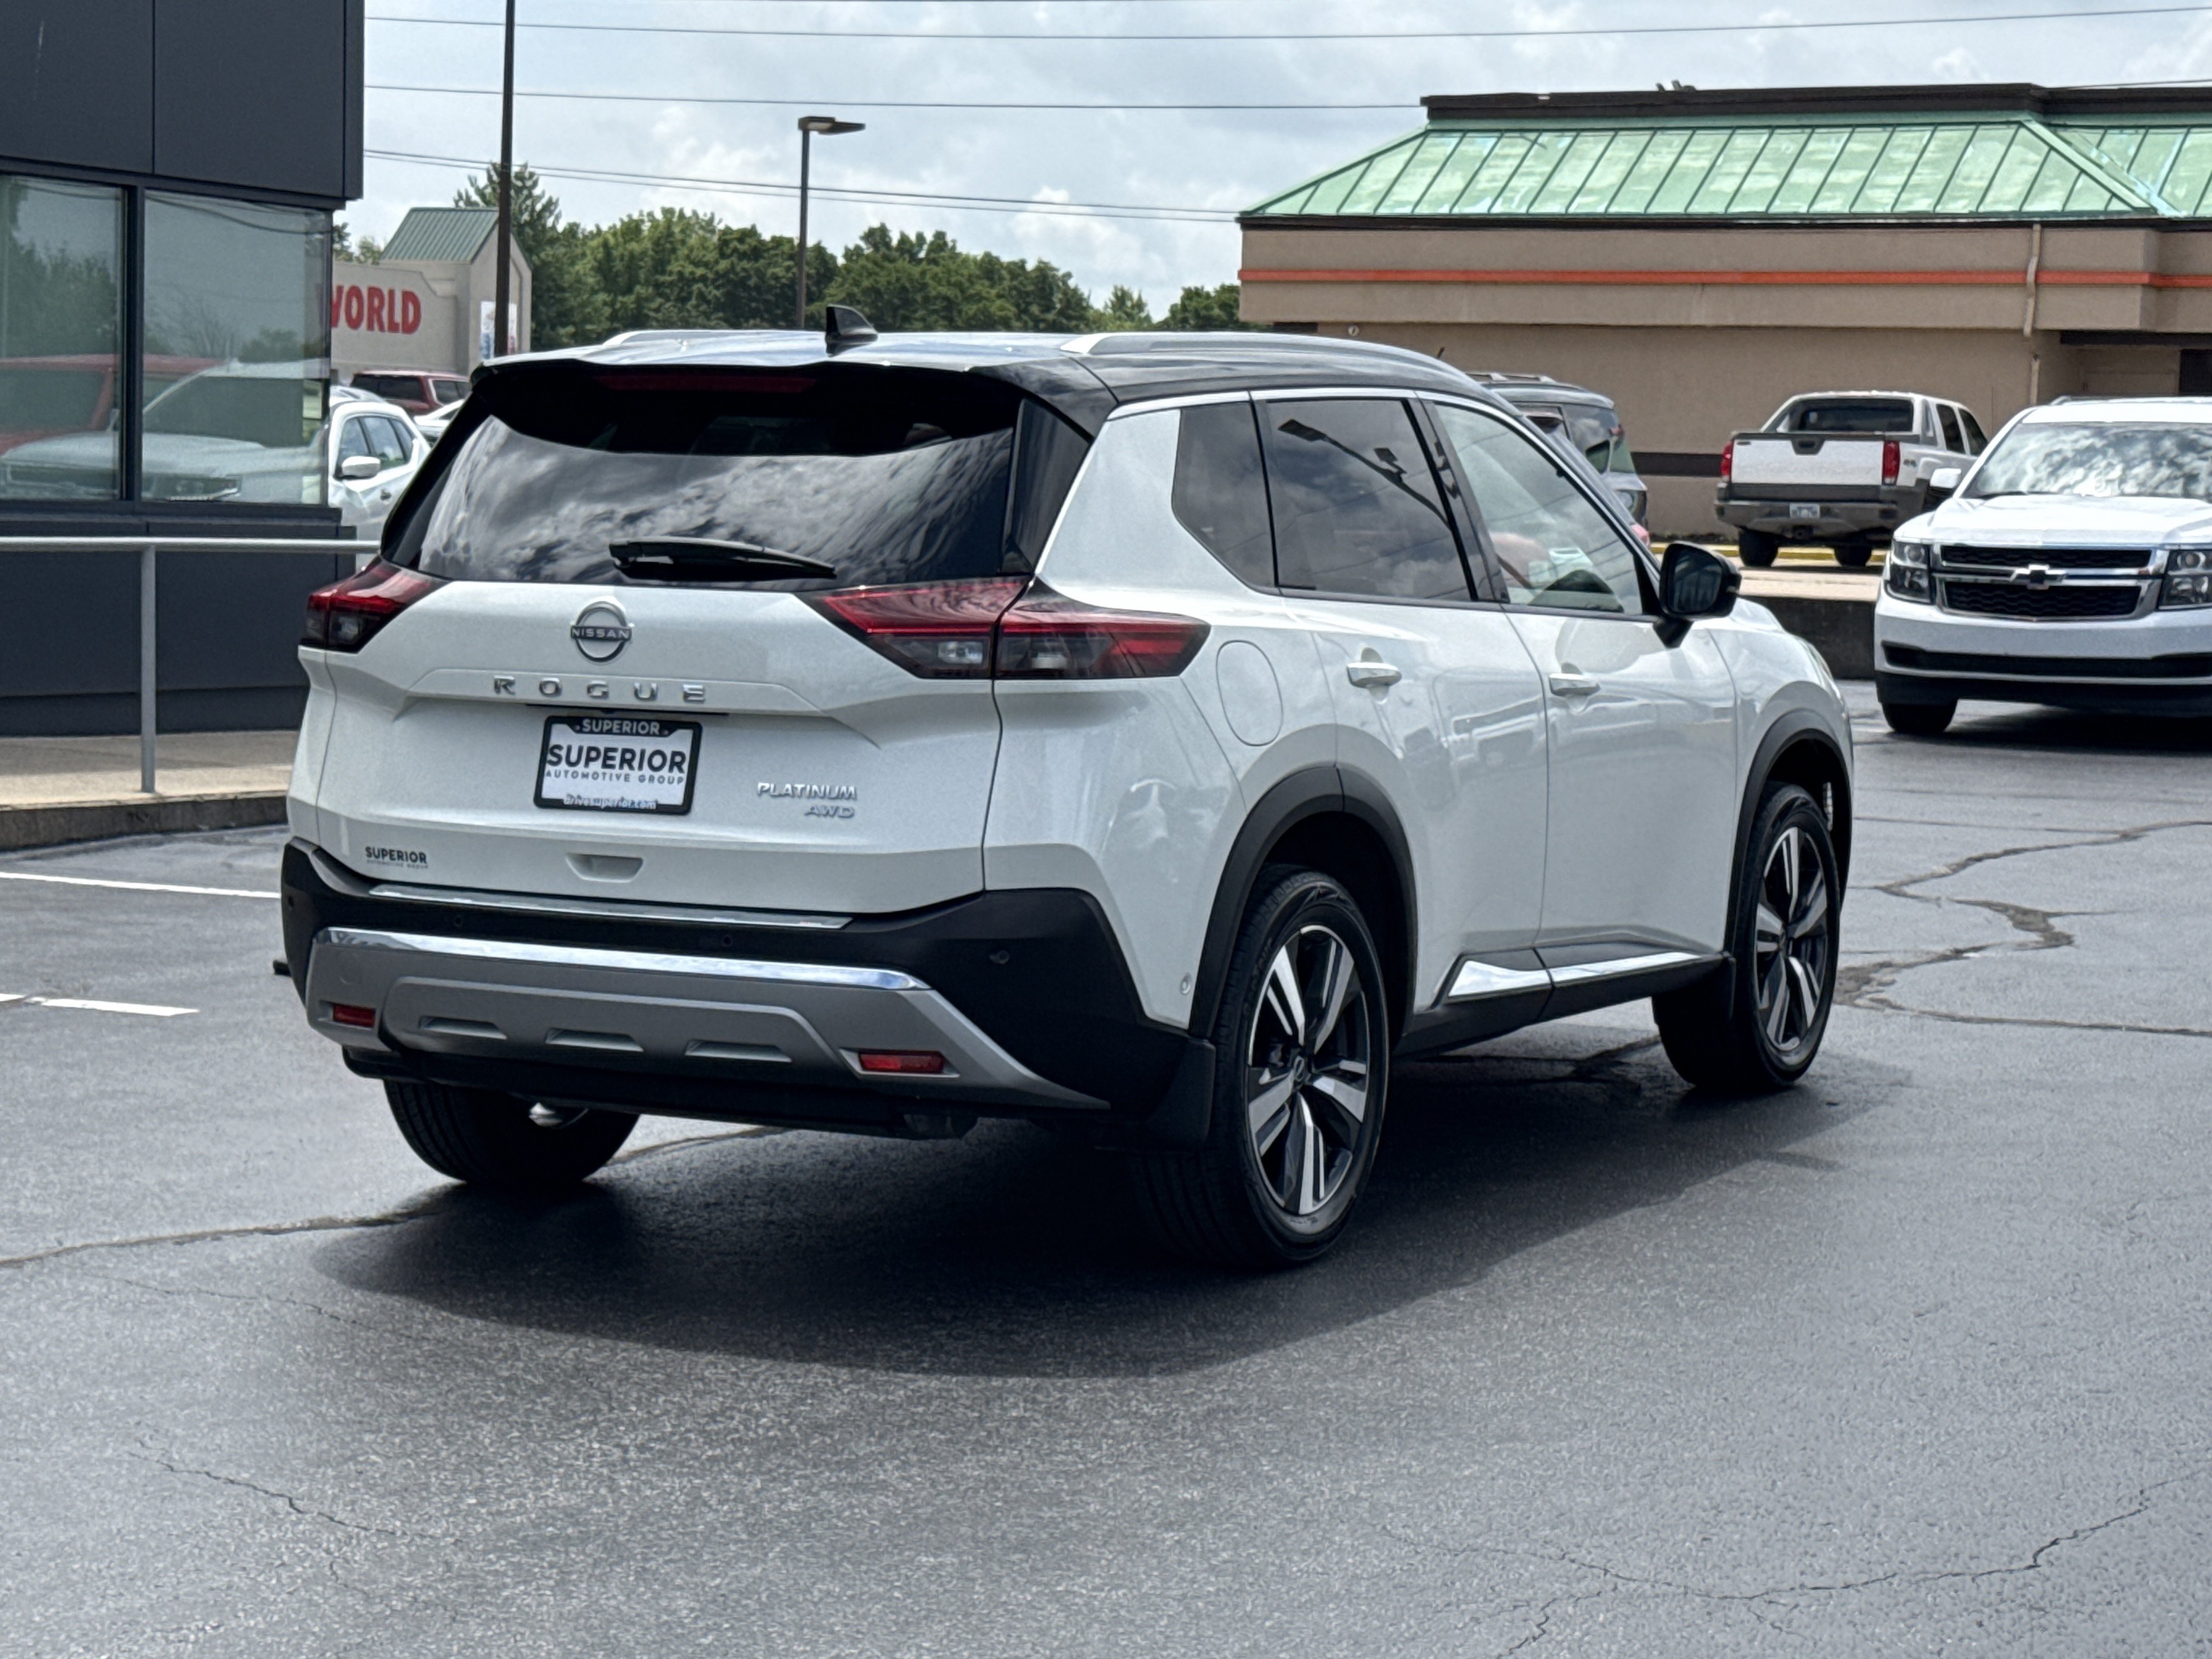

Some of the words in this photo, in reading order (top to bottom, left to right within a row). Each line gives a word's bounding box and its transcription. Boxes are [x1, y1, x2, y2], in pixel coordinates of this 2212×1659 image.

[572, 628, 629, 640] NISSAN
[494, 675, 706, 703] ROGUE
[582, 719, 659, 735] SUPERIOR
[546, 744, 686, 774] SUPERIOR
[546, 769, 631, 782] AUTOMOTIVE
[638, 775, 684, 785] GROUP
[757, 782, 857, 800] PLATINUM
[805, 805, 855, 819] AWD
[365, 847, 427, 864] SUPERIOR
